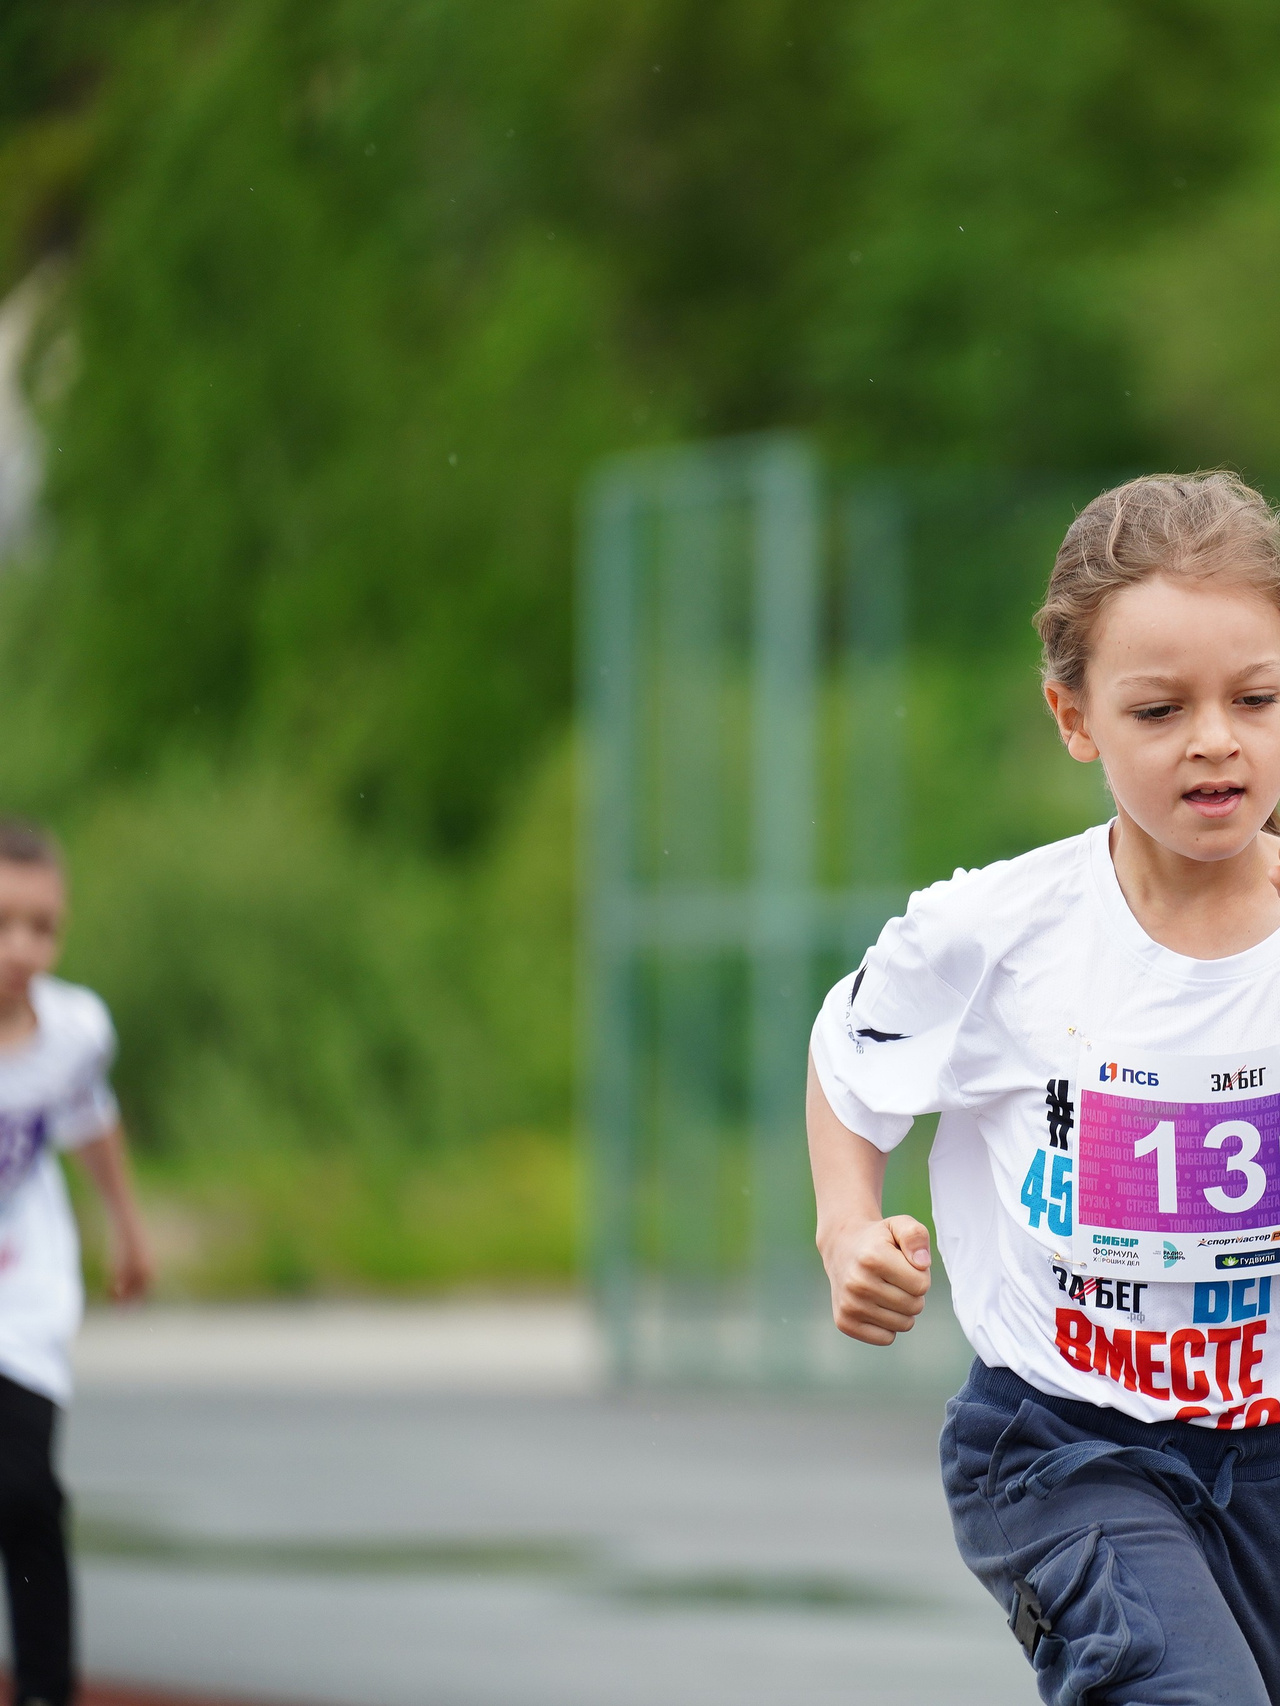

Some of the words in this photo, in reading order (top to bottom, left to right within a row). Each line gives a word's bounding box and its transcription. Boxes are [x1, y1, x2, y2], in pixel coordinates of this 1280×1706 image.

[1122, 1068, 1159, 1086] ПСБ
[1081, 1107, 1108, 1124] АЧАЛО
[1092, 1234, 1139, 1248] СИБУР
[1092, 1247, 1140, 1259] ФОРМУЛА
[1240, 1254, 1276, 1265] ГУДВИЛЛ
[1127, 1259, 1140, 1267] ДЕЛ
[1055, 1307, 1267, 1402] ВМЕСТЕ
